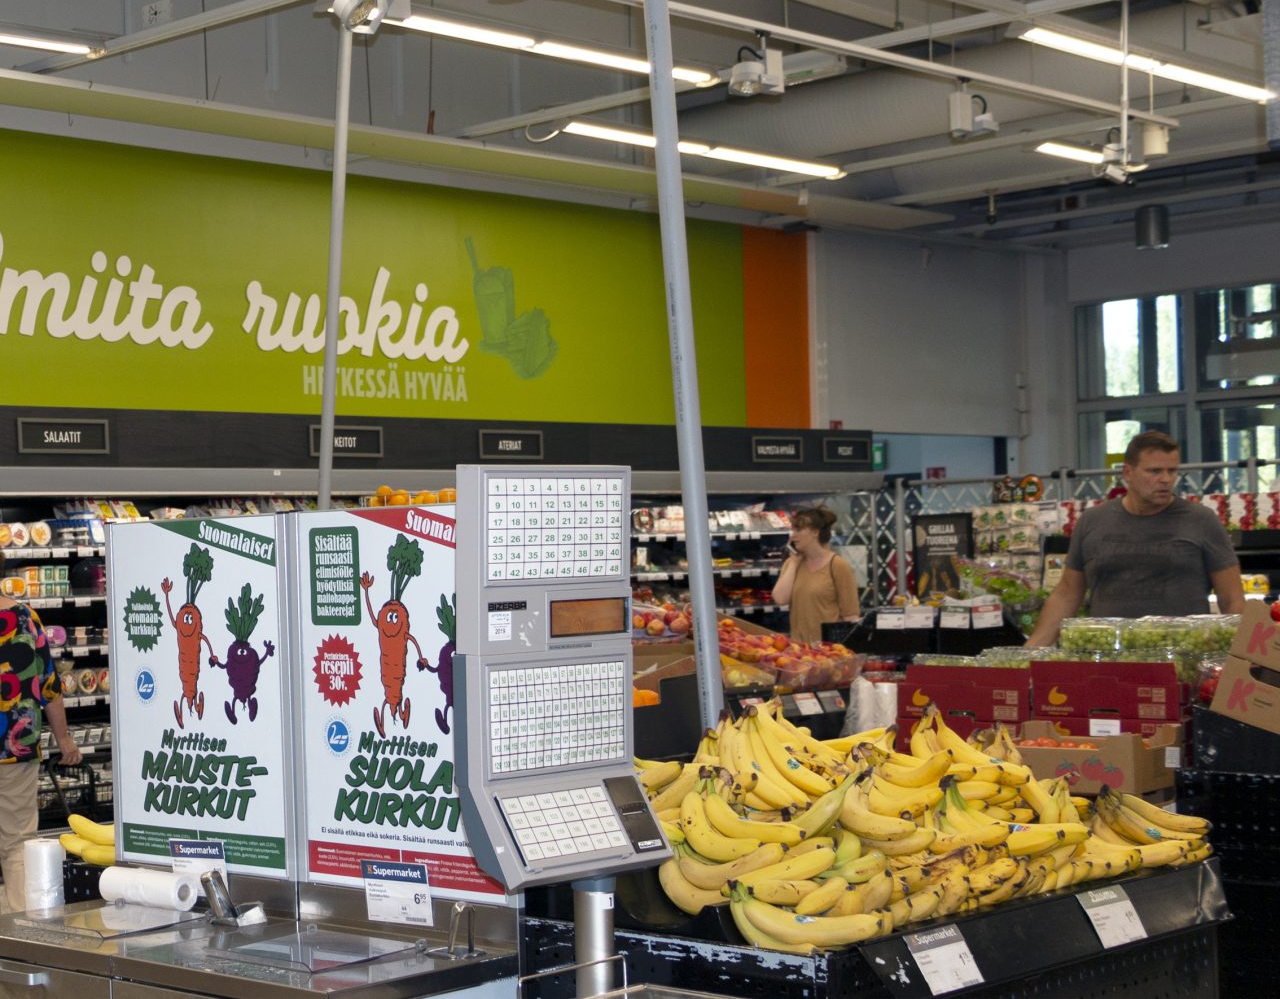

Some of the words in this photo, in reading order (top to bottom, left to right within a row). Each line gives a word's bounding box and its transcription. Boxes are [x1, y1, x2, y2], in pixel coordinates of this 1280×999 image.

[242, 266, 469, 363] ruokia
[405, 366, 468, 401] HYVÄÄ
[43, 429, 81, 444] SALAATIT
[498, 440, 522, 452] ATERIAT
[611, 516, 620, 524] 24
[198, 521, 274, 560] Suomalaiset
[315, 533, 352, 551] Sisältää
[611, 532, 620, 540] 32
[315, 551, 353, 565] runsaasti
[316, 565, 354, 579] elimistölle
[527, 568, 538, 576] 43
[316, 579, 354, 594] hyödyllisiä
[488, 602, 526, 612] BIZERBA
[130, 624, 157, 637] kurkkuja
[1247, 621, 1276, 656] K
[321, 660, 354, 679] resepti
[1227, 678, 1256, 712] K
[161, 728, 227, 752] Myrttisen
[358, 731, 438, 759] Myrttisen
[141, 750, 269, 787] MAUSTE-
[345, 755, 453, 794] SUOLA
[144, 782, 257, 821] KURKUT
[334, 788, 461, 832] KURKUT
[327, 827, 345, 835] sisällä
[345, 829, 365, 837] etikkaa
[366, 831, 379, 839] eikä
[379, 832, 401, 841] sokeria.
[403, 835, 426, 843] Sisältää
[427, 837, 455, 846] runsaasti
[179, 844, 219, 856] Supermarket
[373, 865, 422, 879] Supermarket
[414, 893, 420, 904] 6
[915, 927, 957, 945] Supermarket
